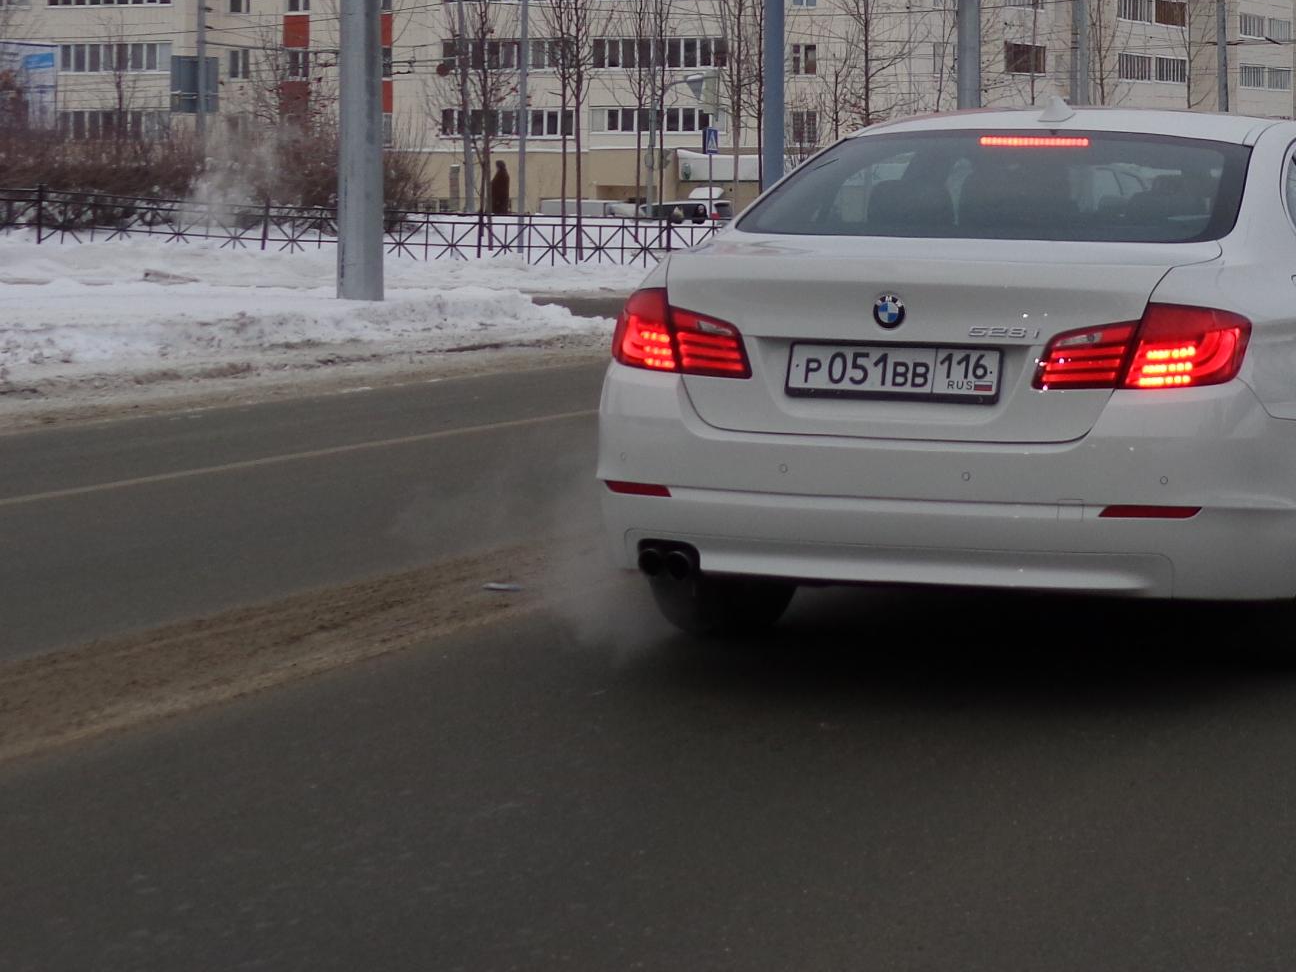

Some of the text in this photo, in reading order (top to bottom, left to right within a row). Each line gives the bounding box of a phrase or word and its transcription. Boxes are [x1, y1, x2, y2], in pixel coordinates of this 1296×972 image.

[968, 326, 1040, 339] 528i
[939, 352, 987, 380] 116
[947, 380, 973, 391] RUS
